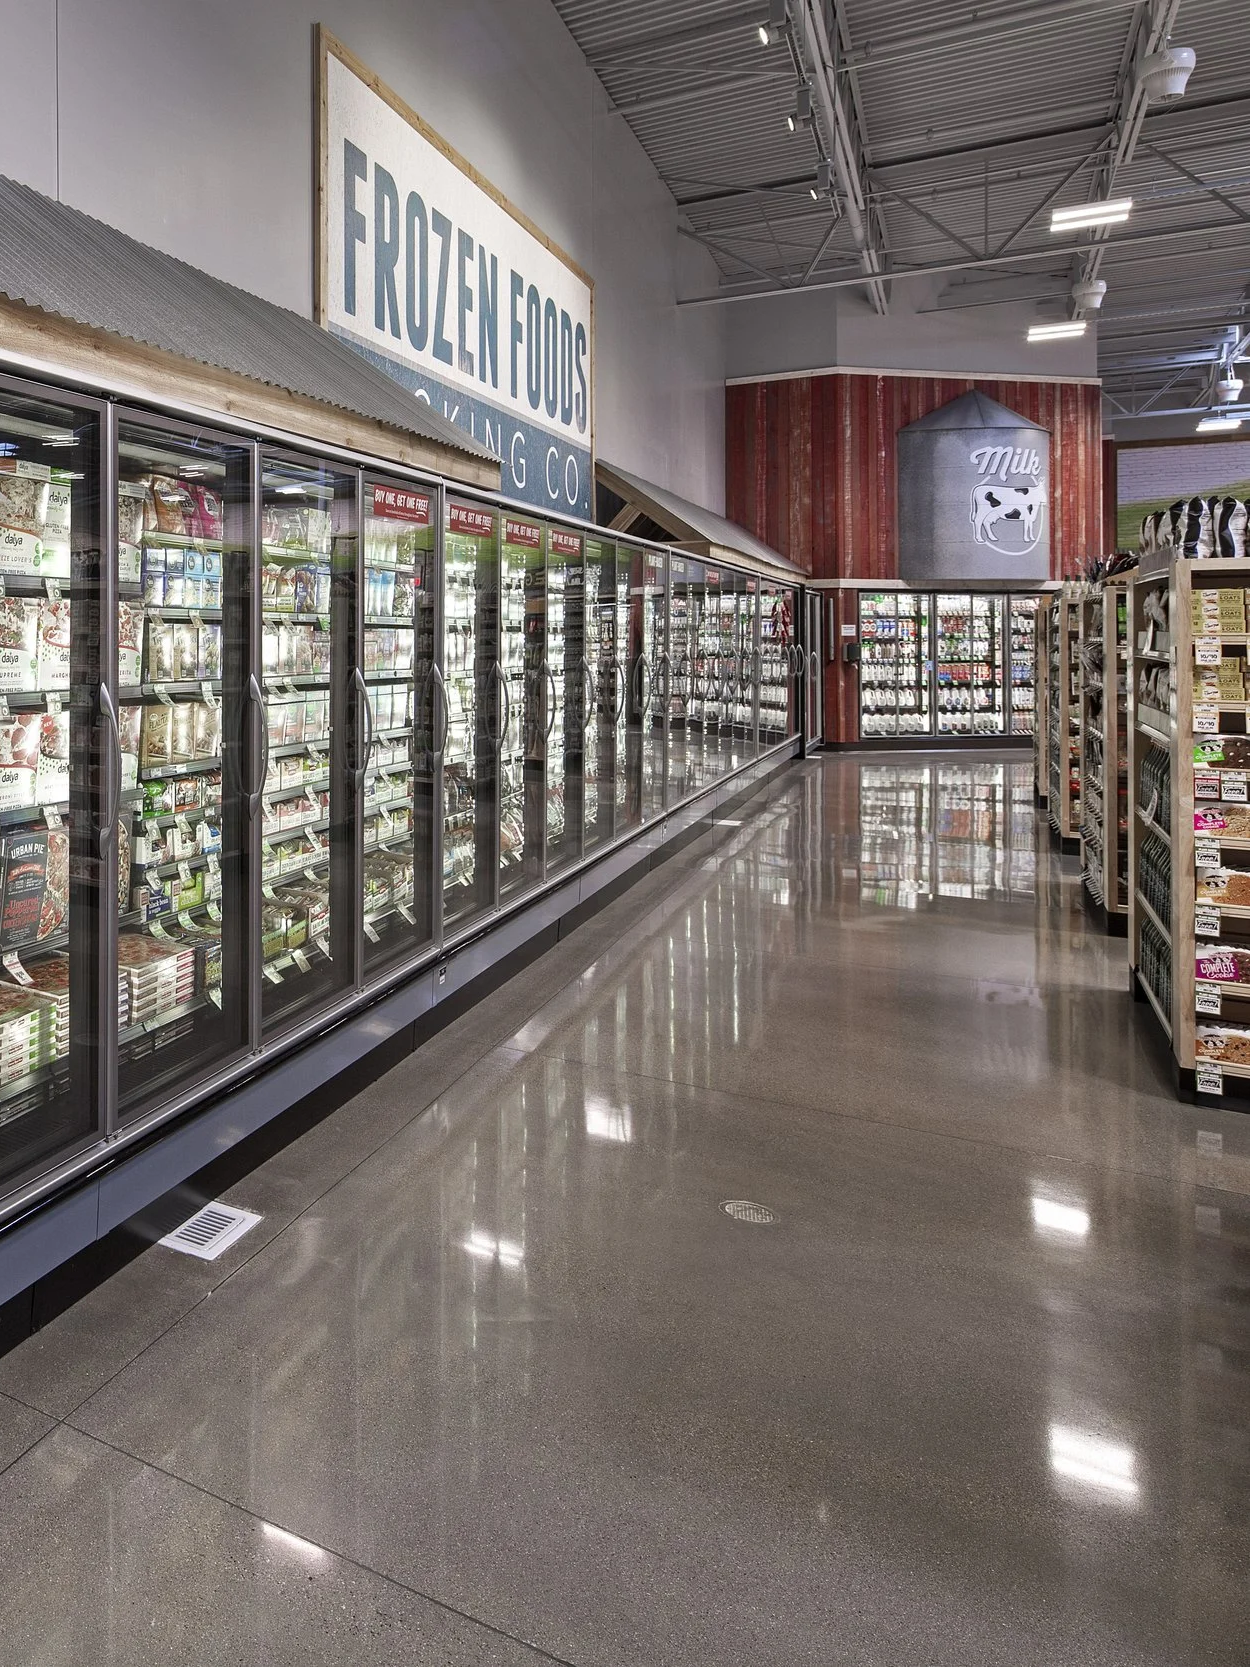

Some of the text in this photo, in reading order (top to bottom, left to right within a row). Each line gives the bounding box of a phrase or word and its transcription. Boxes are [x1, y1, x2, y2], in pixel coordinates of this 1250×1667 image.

[343, 137, 587, 436] FROZEN FOODS
[969, 445, 1041, 482] Milk
[546, 446, 589, 509] CO.
[375, 489, 428, 512] BUY ONE, GET ONE FREE!
[451, 507, 459, 519] BUY
[4, 534, 23, 546] daiya
[1, 652, 19, 664] daiya
[1, 772, 19, 783] daiya
[11, 844, 45, 859] URBAN PIE
[1201, 963, 1235, 974] COMPLETE
